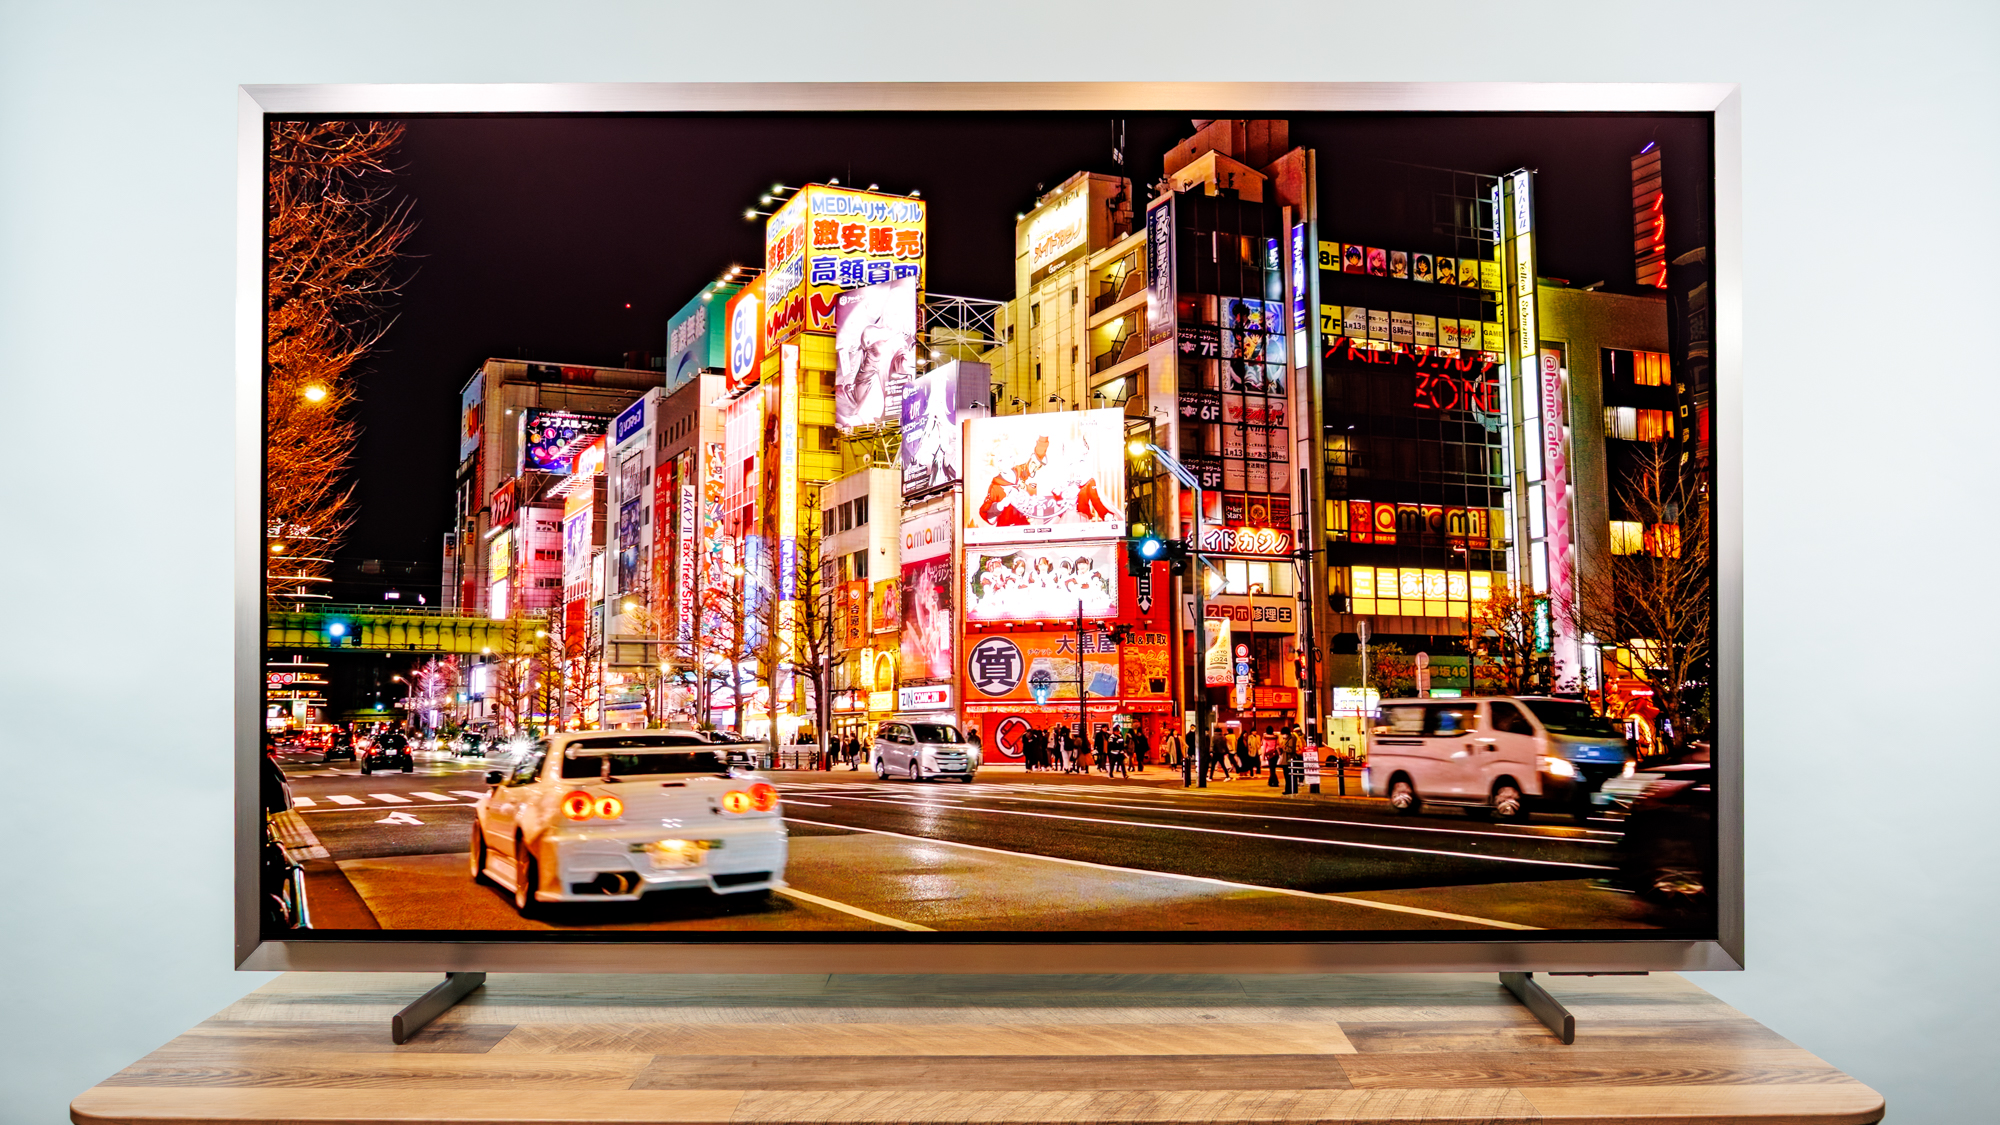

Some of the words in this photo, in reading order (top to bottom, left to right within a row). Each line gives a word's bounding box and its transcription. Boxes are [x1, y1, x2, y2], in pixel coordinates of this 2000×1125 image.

[813, 219, 920, 257] 激安販売
[1319, 250, 1339, 266] 8F
[1519, 260, 1527, 292] Yellow
[1321, 314, 1341, 330] 7F
[1344, 321, 1366, 331] 1月13日
[1392, 326, 1413, 336] 8時から
[1483, 329, 1503, 337] GAME
[734, 335, 754, 374] GO
[1200, 341, 1218, 356] 7F
[1543, 356, 1557, 420] @home
[1200, 405, 1219, 420] 6F
[1203, 472, 1221, 487] 5F
[683, 488, 693, 520] AKKY
[906, 524, 945, 550] amiami
[682, 537, 693, 589] Tax-free
[1402, 574, 1466, 597] あみあみ
[1206, 605, 1292, 622] スマホ修理王
[1027, 648, 1053, 656] チケット
[1055, 634, 1117, 655] 大黒屋
[975, 645, 1017, 689] 質
[1063, 712, 1097, 721] チケト
